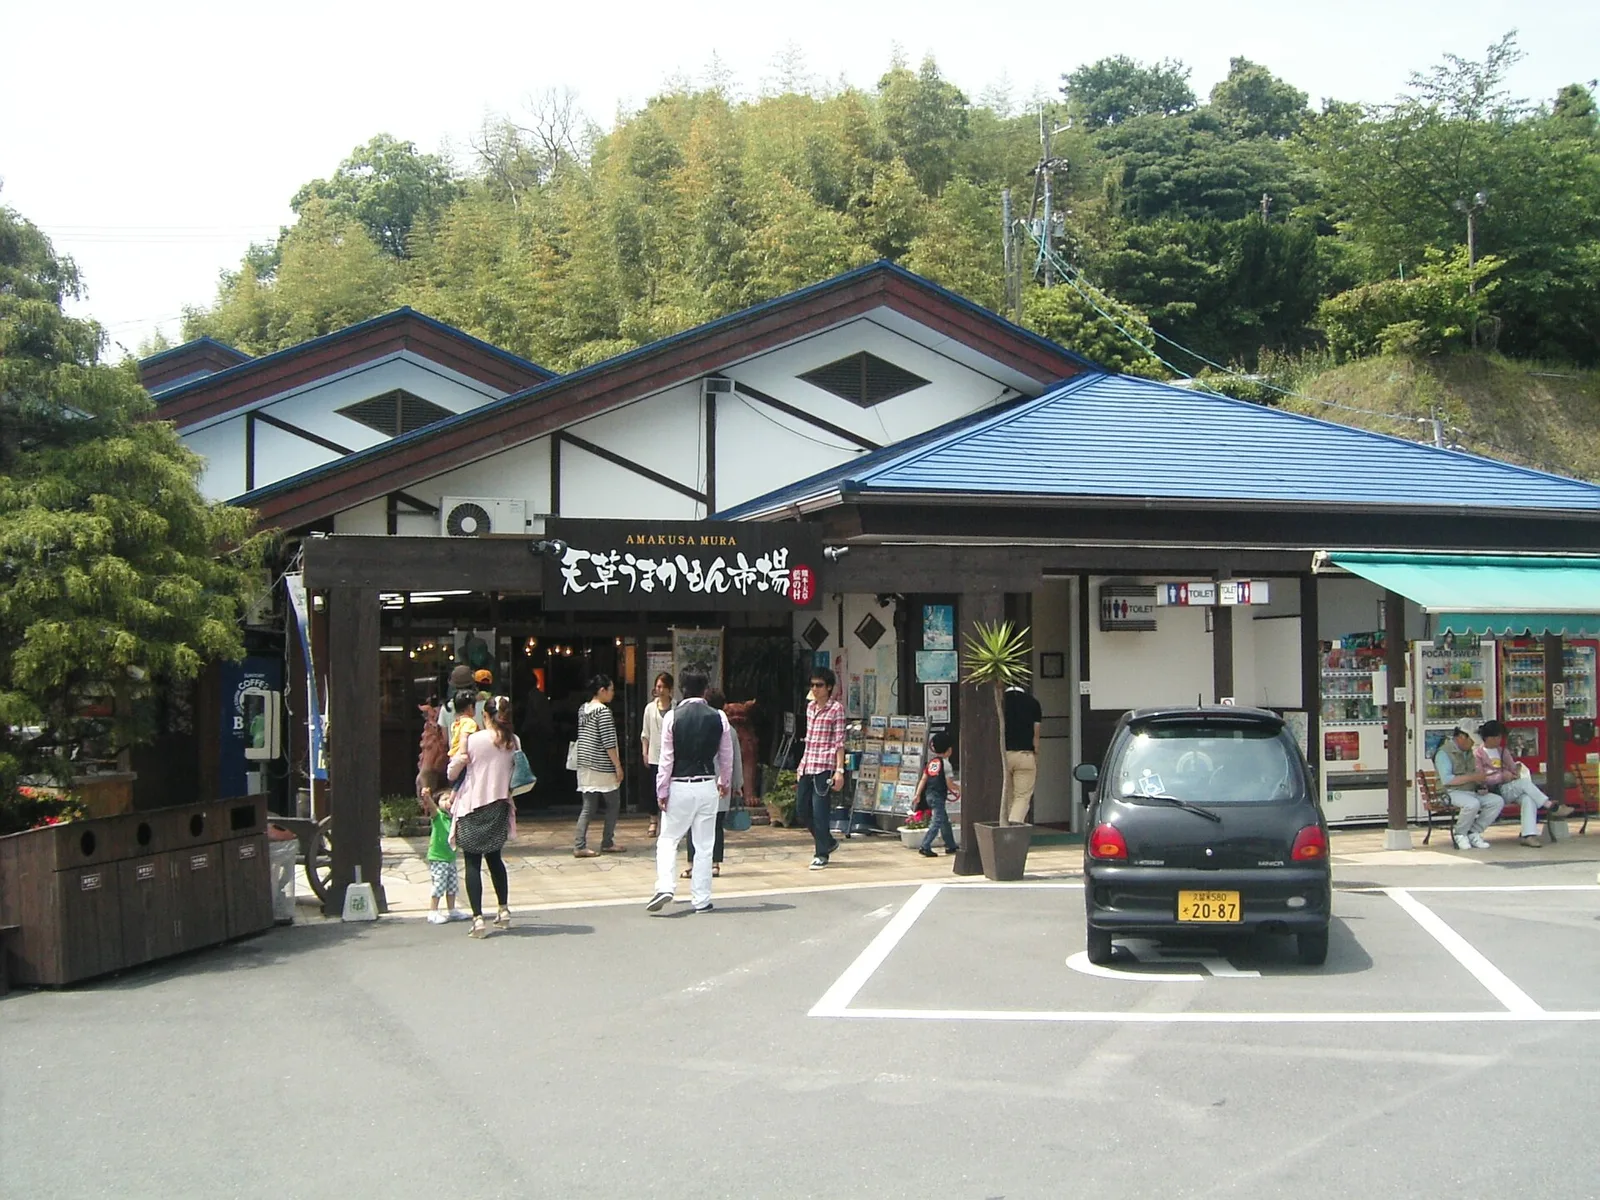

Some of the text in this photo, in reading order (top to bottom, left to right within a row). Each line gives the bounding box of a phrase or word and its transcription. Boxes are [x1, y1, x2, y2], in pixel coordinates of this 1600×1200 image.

[626, 535, 737, 546] AMAKUSA MURA
[560, 547, 790, 596] 天草うまかもん市場
[1189, 590, 1214, 598] TOILET
[1221, 586, 1237, 594] TOILET
[1128, 605, 1154, 613] TOILET
[1422, 650, 1481, 658] POCARI SWEAT
[1192, 903, 1236, 919] 20-87
